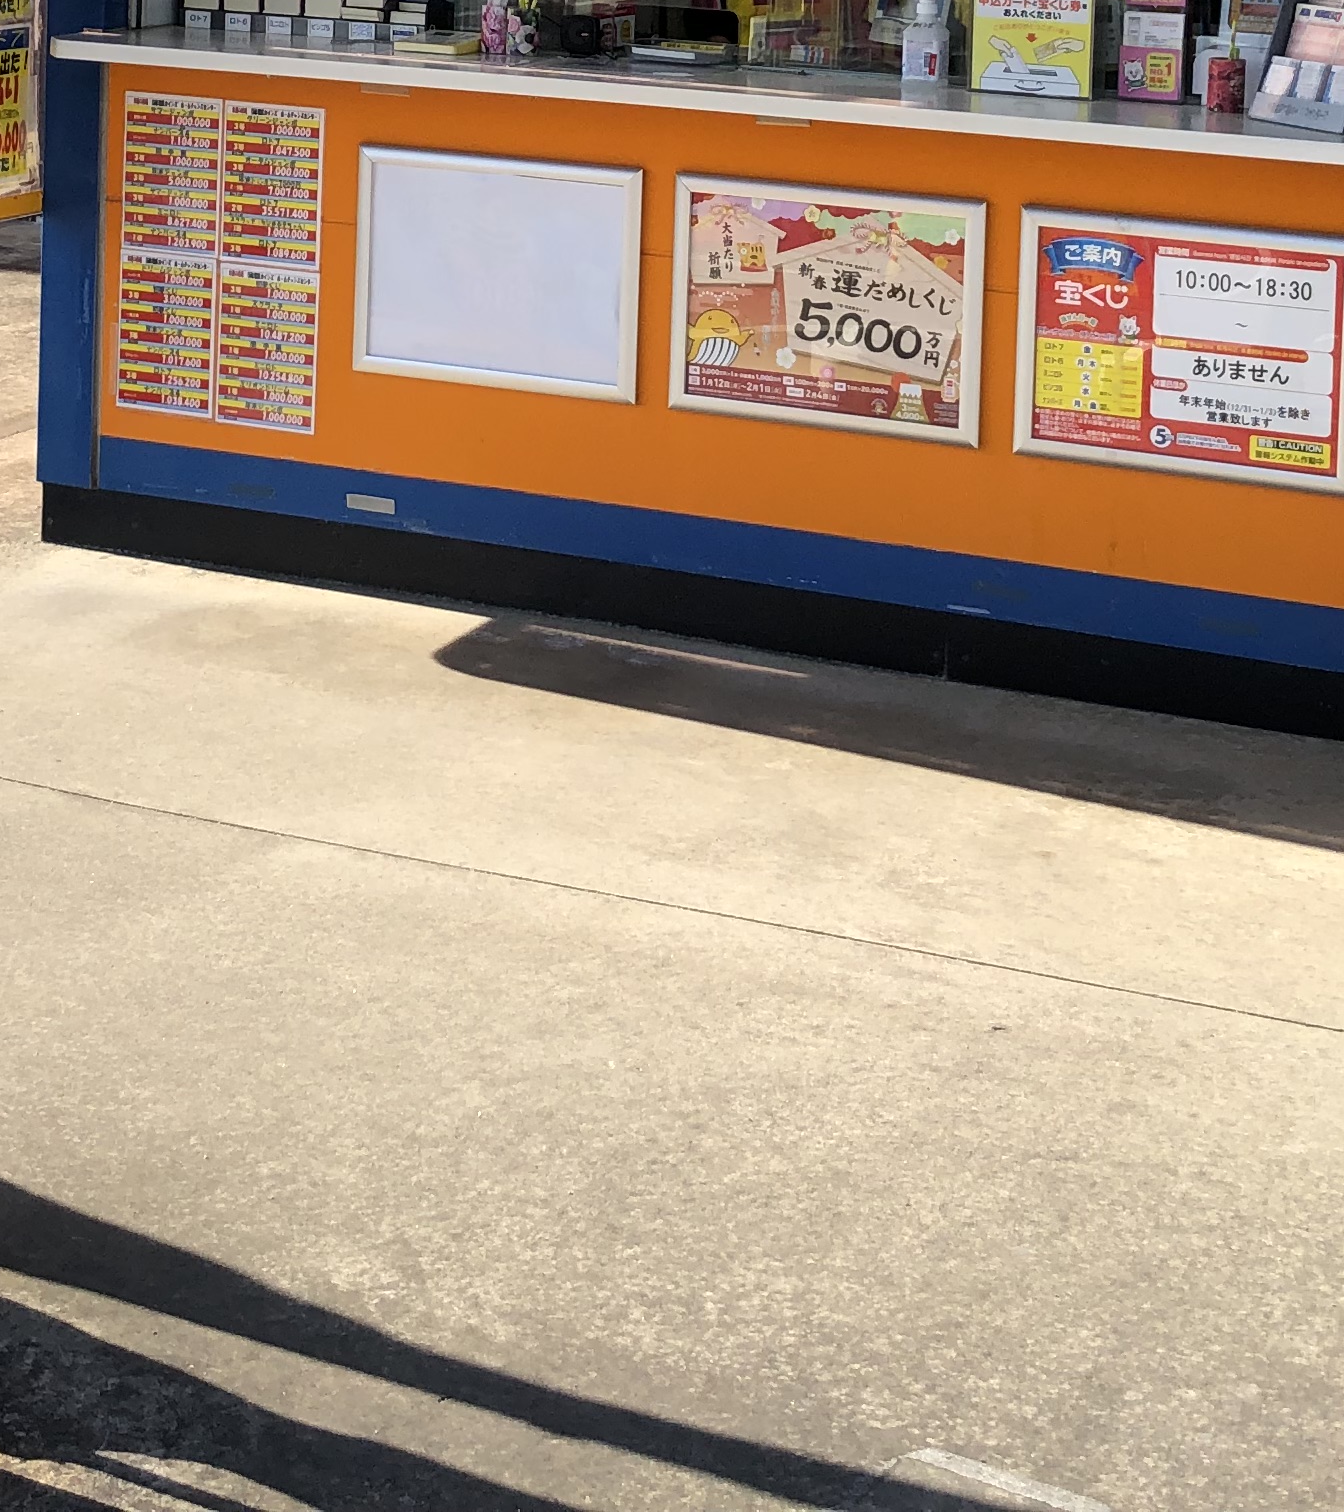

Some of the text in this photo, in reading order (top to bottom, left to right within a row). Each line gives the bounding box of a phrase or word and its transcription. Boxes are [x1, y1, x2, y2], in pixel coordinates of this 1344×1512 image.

[1003, 9, 1062, 20] お入れください
[722, 221, 735, 273] 大当たり
[1064, 244, 1122, 267] ご案内
[706, 251, 723, 280] 祈願
[798, 261, 956, 316] 新春運だめしくじ
[1054, 279, 1129, 309] 宝くじ
[1176, 269, 1313, 301] 10:00～18:30
[1192, 355, 1290, 385] ありません
[1206, 411, 1273, 428] 営業致します
[1278, 441, 1324, 454] CAUTION
